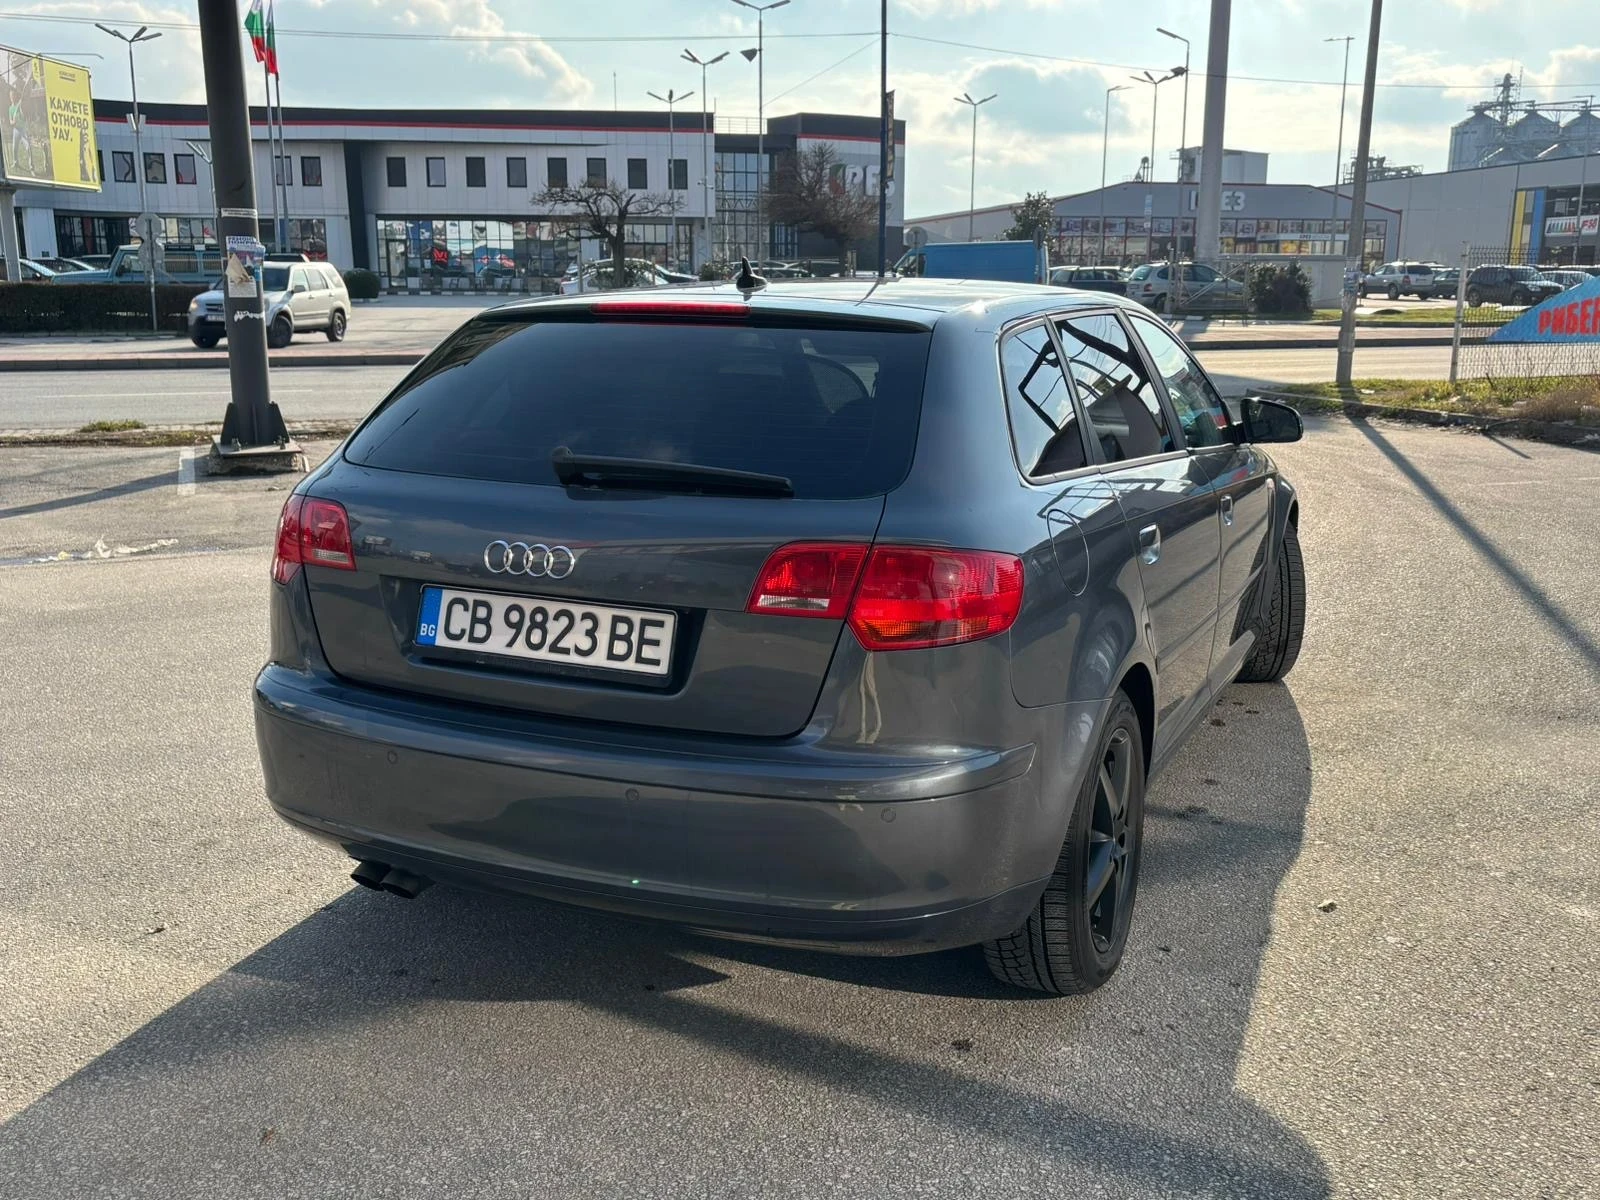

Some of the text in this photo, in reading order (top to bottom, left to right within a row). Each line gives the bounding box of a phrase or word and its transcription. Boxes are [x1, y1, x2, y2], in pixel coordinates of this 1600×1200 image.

[50, 96, 89, 116] КАЖЕТЕ
[51, 112, 89, 130] ОТНОВО
[52, 126, 73, 142] УАУ.
[420, 623, 435, 637] BG
[443, 597, 665, 667] CB 9823 BE
